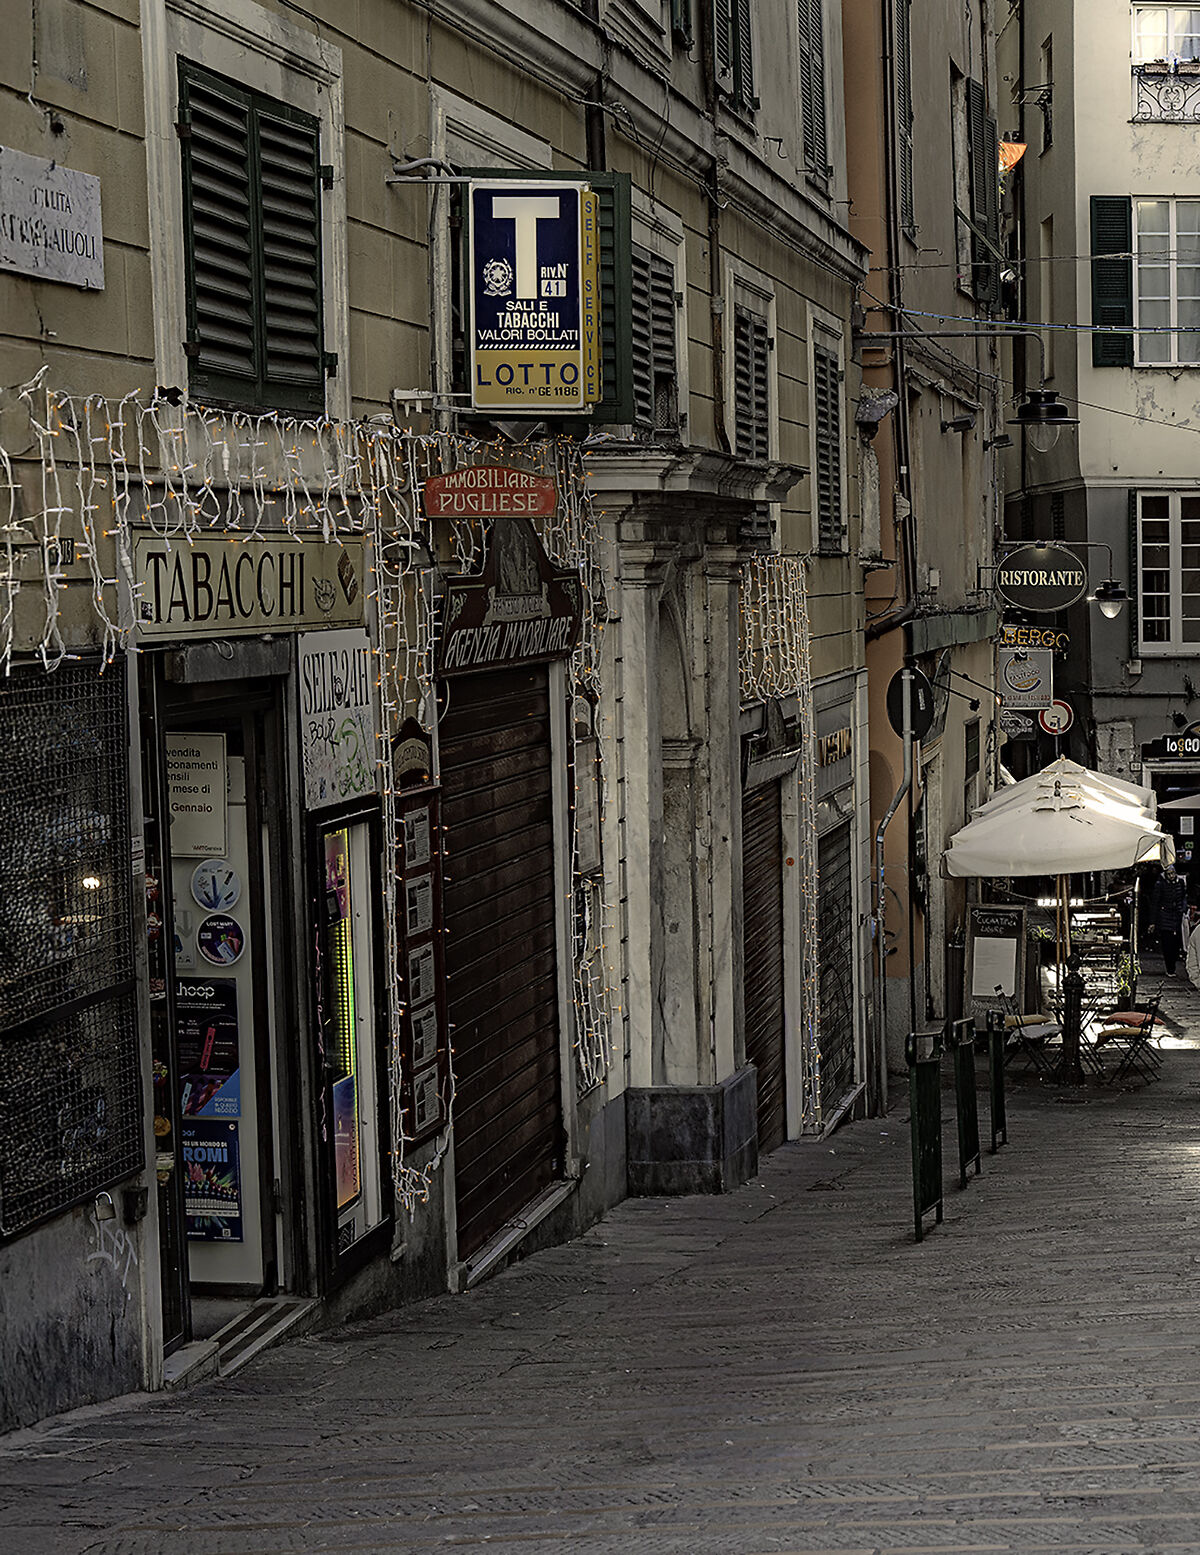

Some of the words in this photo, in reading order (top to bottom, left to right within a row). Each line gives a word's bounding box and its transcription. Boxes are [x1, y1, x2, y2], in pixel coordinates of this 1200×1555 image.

[584, 201, 593, 265] SELF
[491, 196, 560, 299] T
[544, 281, 561, 295] 41
[506, 301, 534, 311] SALI
[540, 301, 548, 311] E
[497, 312, 560, 328] TABACCHI
[478, 330, 523, 340] VALORI
[527, 330, 578, 340] BOLLATI
[584, 280, 595, 395] SERVICE
[477, 363, 579, 386] LOTTO
[538, 387, 551, 396] GE
[554, 387, 579, 396] 1186
[445, 468, 536, 488] IMMOBILIARE
[439, 493, 539, 512] PUGLIESE
[999, 570, 1083, 586] RISTORANTE
[146, 550, 305, 624] TABACCHI
[445, 624, 502, 669] AGENZIA
[500, 615, 573, 661] IMMOBILIARE
[172, 785, 199, 793] mese
[201, 784, 211, 793] di
[171, 802, 213, 813] Gennaio
